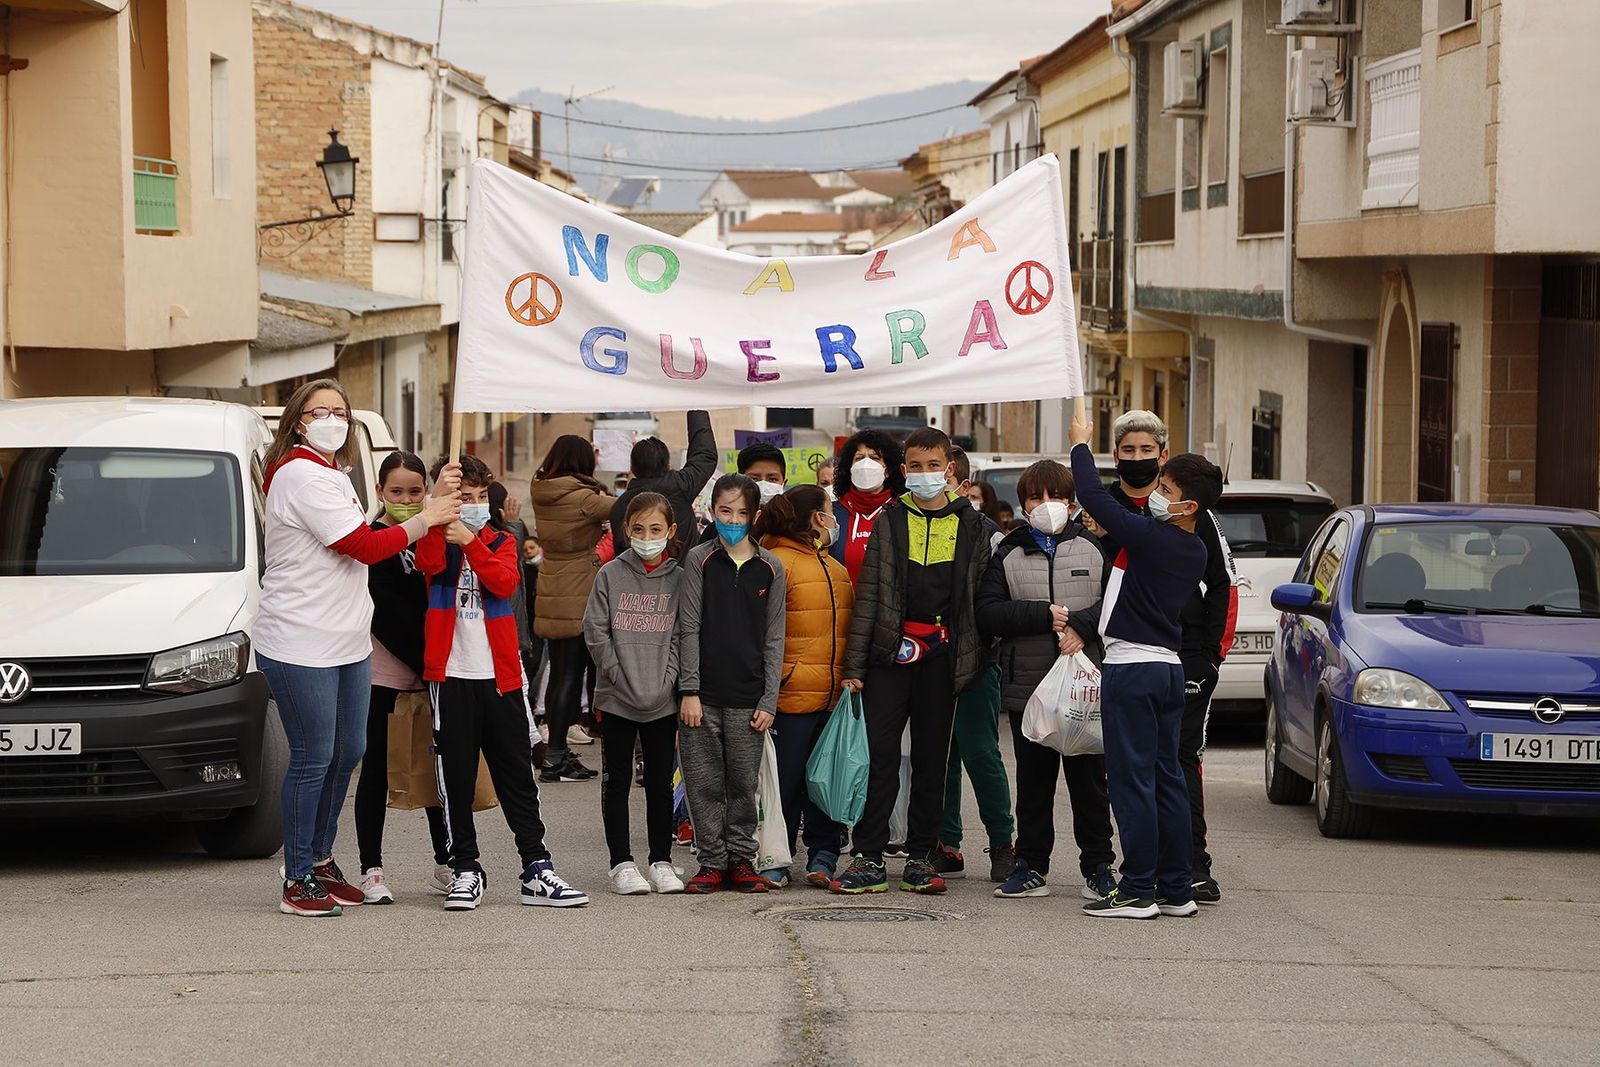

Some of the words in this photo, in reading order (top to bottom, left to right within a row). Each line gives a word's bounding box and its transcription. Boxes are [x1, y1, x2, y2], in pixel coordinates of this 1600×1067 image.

[563, 225, 680, 293] NO
[742, 259, 795, 295] A
[865, 217, 997, 281] LA
[579, 300, 1008, 383] GUERRA
[618, 592, 657, 612] MAKE
[658, 593, 672, 611] IT
[24, 729, 72, 751] JJZ
[1503, 738, 1553, 759] 1491
